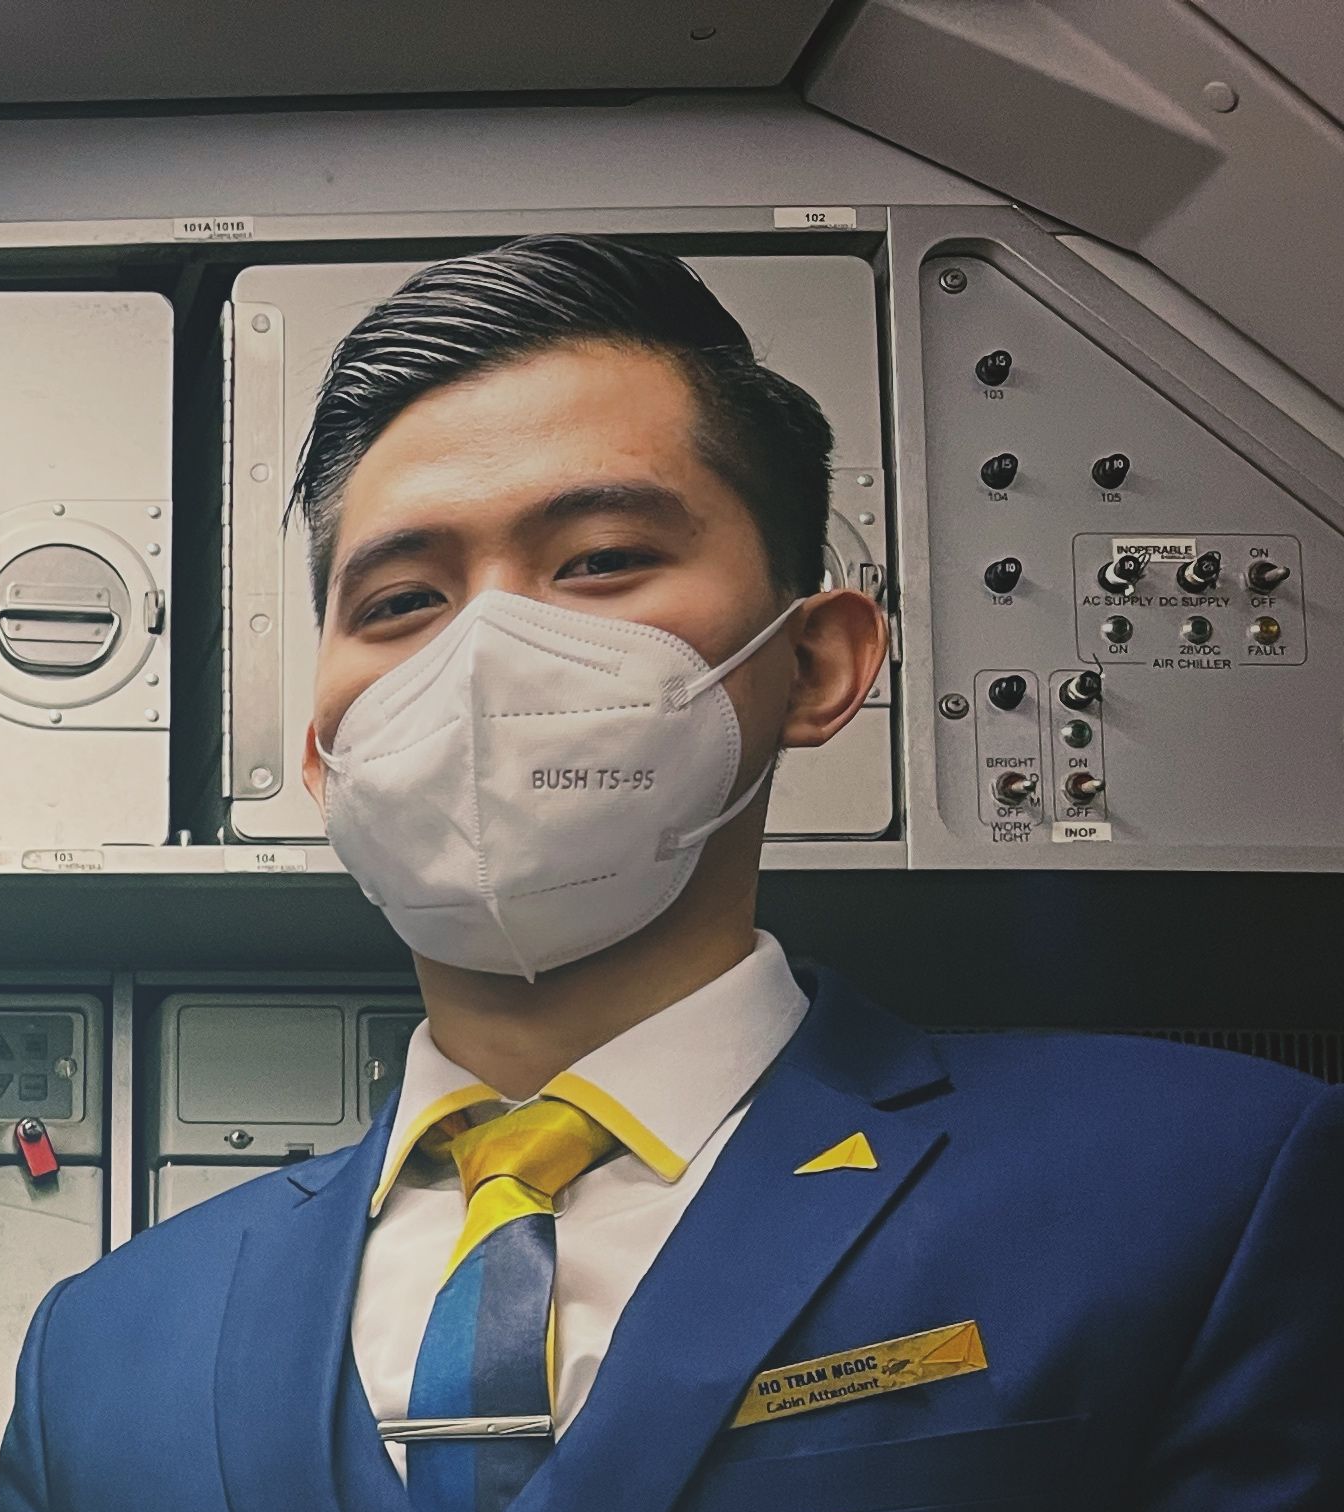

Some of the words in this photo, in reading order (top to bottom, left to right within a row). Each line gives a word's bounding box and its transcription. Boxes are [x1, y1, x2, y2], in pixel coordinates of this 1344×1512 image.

[805, 213, 826, 223] 102
[184, 223, 212, 232] 101A
[216, 221, 245, 232] 101B
[983, 389, 1004, 400] 103
[988, 492, 1009, 502] 104
[1101, 492, 1122, 502] 105
[1116, 545, 1193, 555] INOPERABLE
[1250, 548, 1269, 558] ON
[1083, 597, 1100, 607] AC
[1104, 597, 1154, 607] SUPPLY
[1159, 597, 1179, 607] DC
[1182, 597, 1230, 608] SUPPLY
[1251, 598, 1276, 608] OFF
[1108, 645, 1128, 654] ON
[1248, 645, 1287, 656] FAULT
[1153, 659, 1174, 669] AIR
[1177, 659, 1232, 669] CHILLER
[986, 757, 1036, 768] BRIGHT
[1068, 758, 1088, 768] ON
[532, 769, 589, 790] BUSH
[596, 769, 656, 790] TS-95
[997, 807, 1024, 818] OFF
[1066, 807, 1093, 818] OFF
[991, 822, 1032, 832] WORK
[992, 832, 1031, 843] LIGHT
[1065, 827, 1097, 838] INOP
[54, 853, 74, 862] 103
[255, 853, 276, 863] 104
[758, 1378, 782, 1396] HO
[784, 1368, 827, 1389] TRAN
[831, 1356, 878, 1379] NGOC
[766, 1396, 806, 1414] Cabin
[808, 1377, 880, 1404] Attendant
